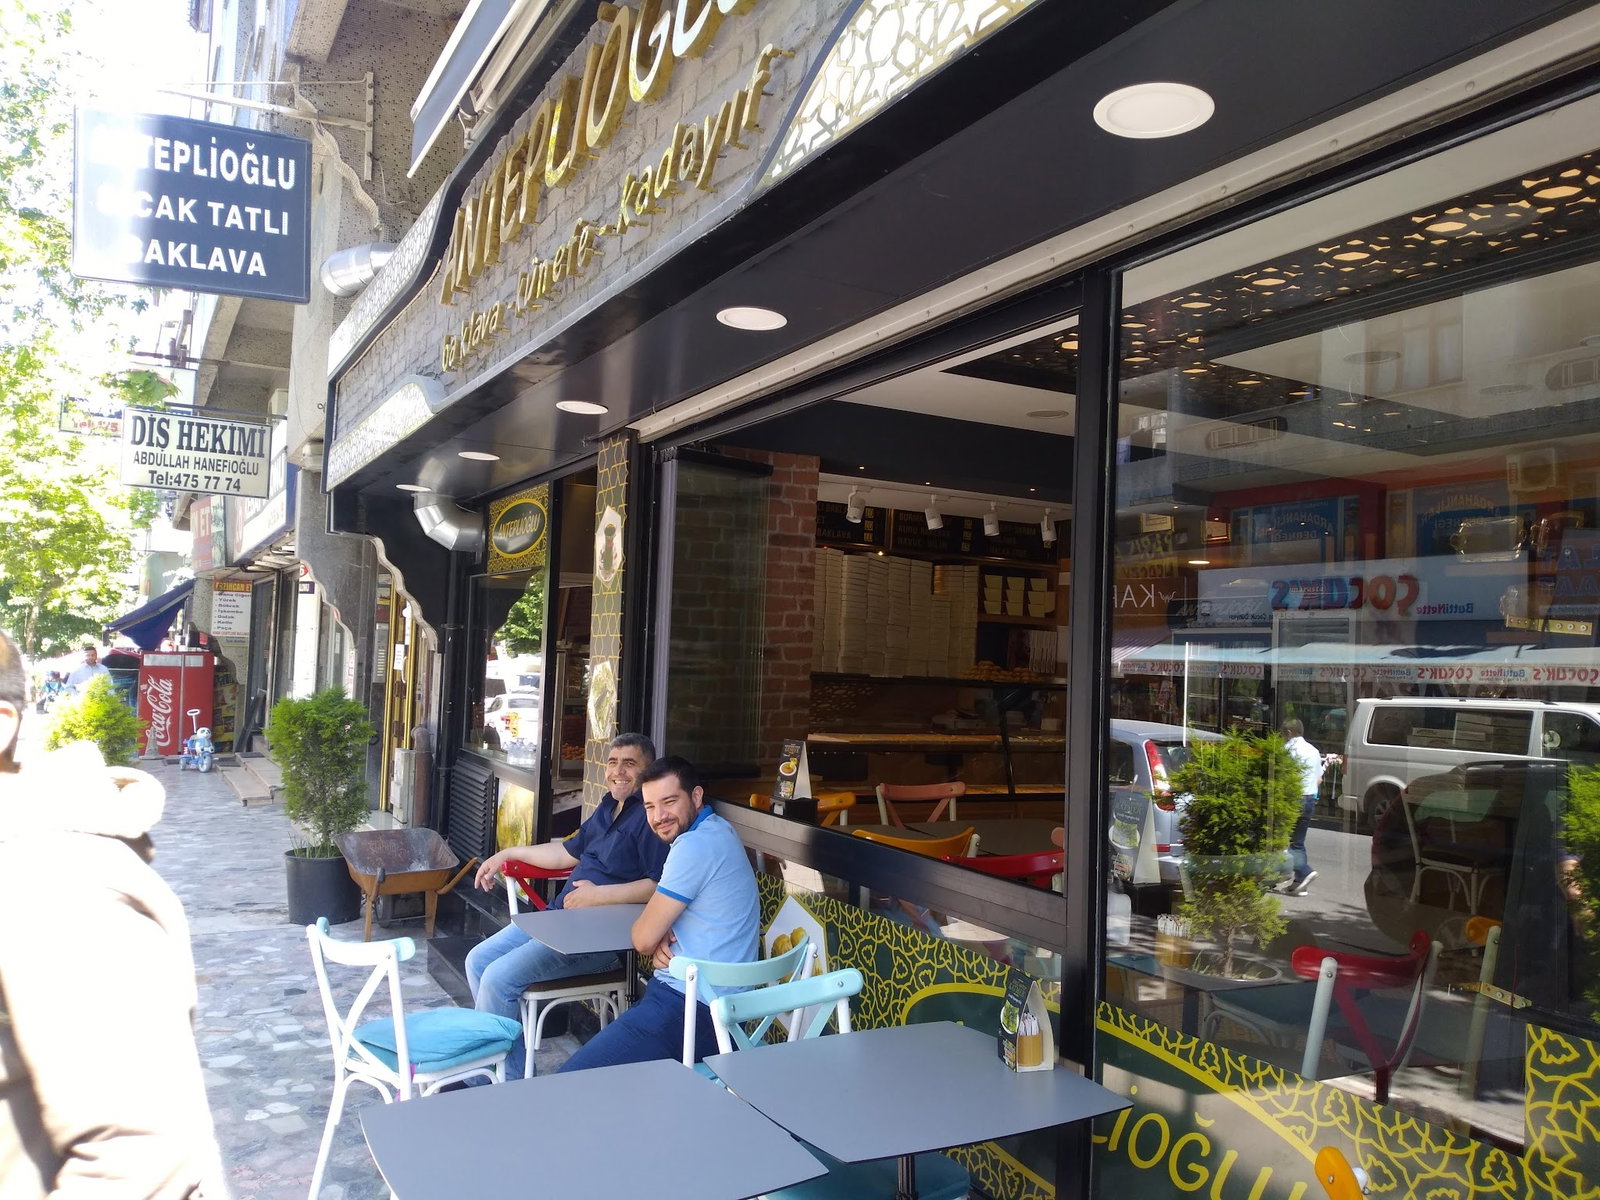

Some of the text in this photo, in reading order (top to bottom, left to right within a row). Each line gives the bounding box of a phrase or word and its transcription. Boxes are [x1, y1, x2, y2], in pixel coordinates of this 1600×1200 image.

[92, 130, 296, 190] TEPLİOĞLU
[97, 188, 289, 236] CAK TATLI
[176, 421, 267, 459] HEKİMİ
[133, 451, 190, 470] ABDULLAH
[193, 456, 260, 476] HANEFİOĞLU
[148, 470, 241, 492] Tel:475 77 74
[1092, 1085, 1308, 1200] İOĞLU
